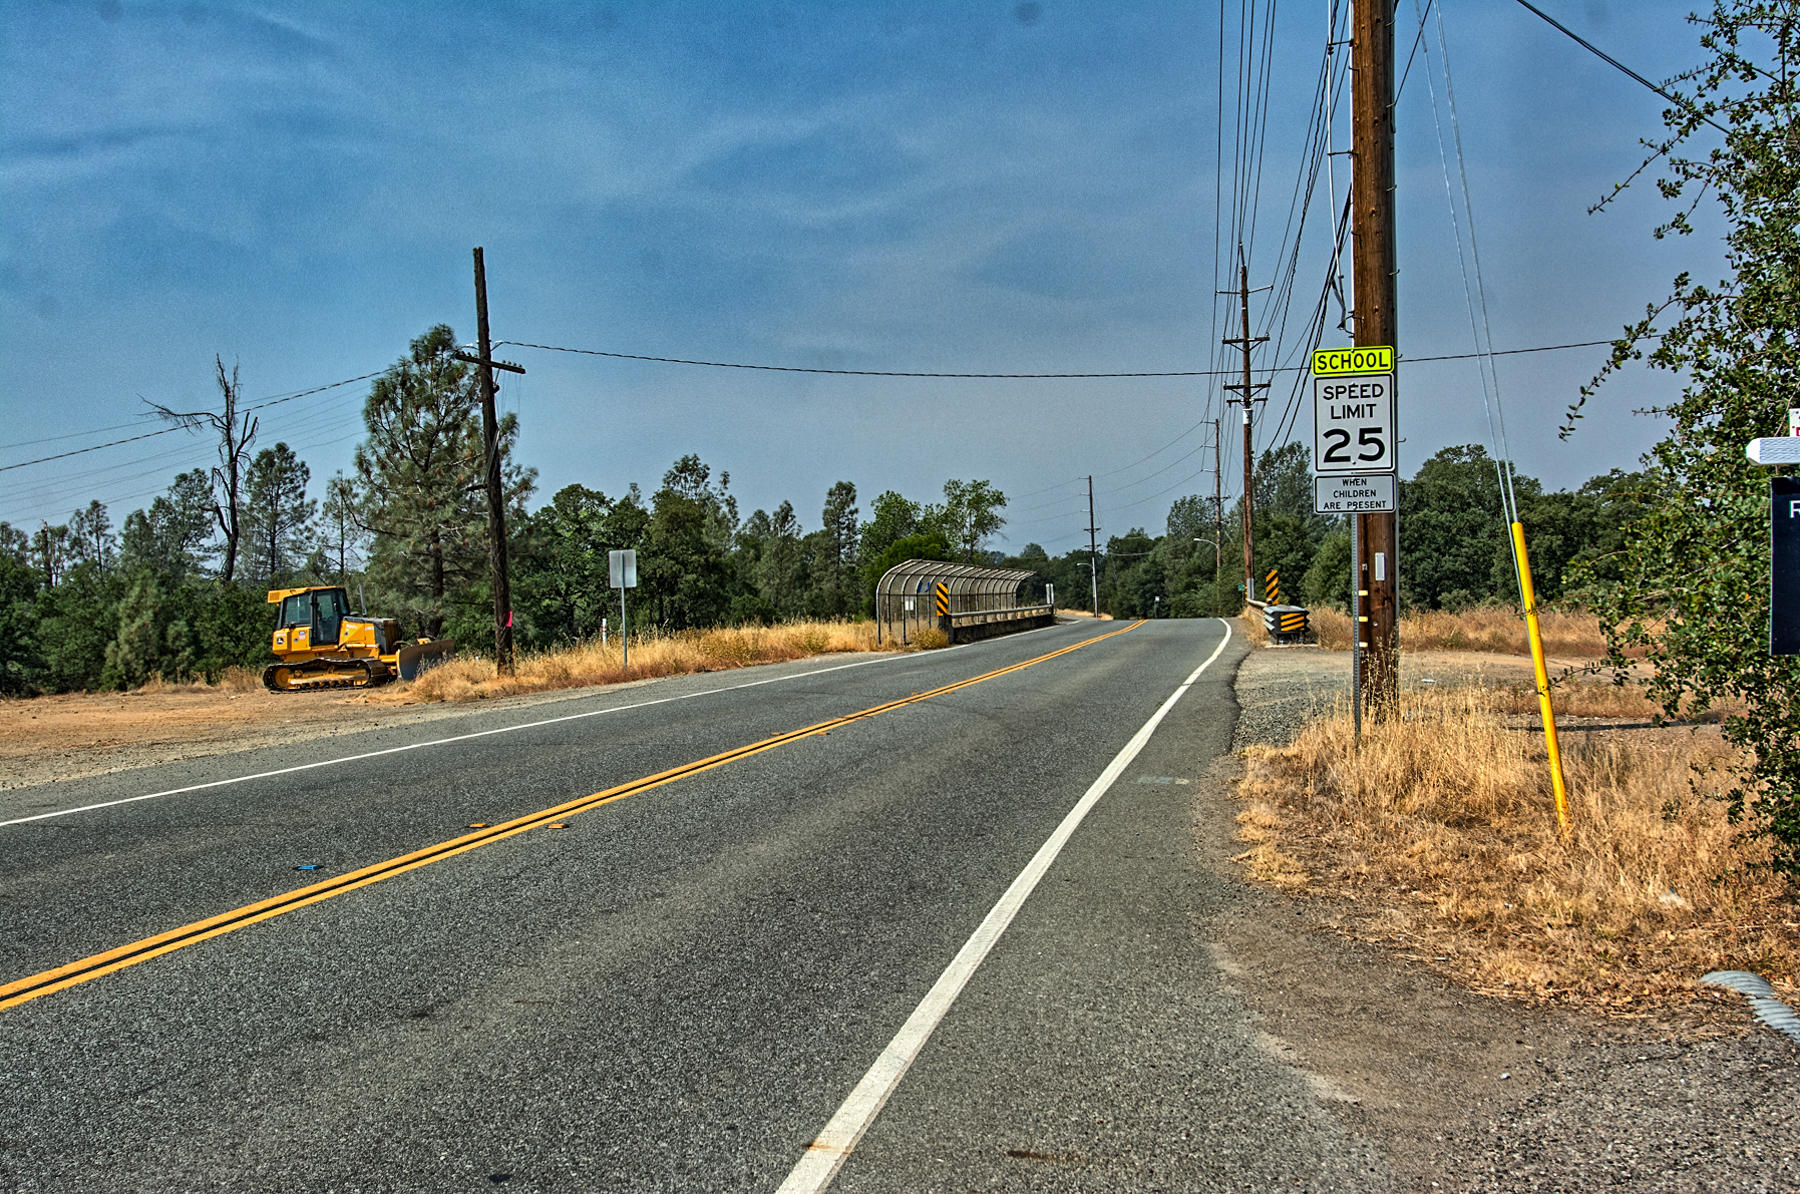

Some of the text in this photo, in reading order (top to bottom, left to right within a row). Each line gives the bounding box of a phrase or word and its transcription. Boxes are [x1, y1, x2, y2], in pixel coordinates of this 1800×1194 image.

[1317, 352, 1389, 370] SCHOOL
[1323, 383, 1384, 400] SPEED
[1330, 404, 1377, 419] LIMIT
[1322, 427, 1386, 463] 25
[1342, 478, 1367, 486] WHEN
[1333, 489, 1377, 498] CHILDREN
[1323, 500, 1386, 510] ARE PRESENT
